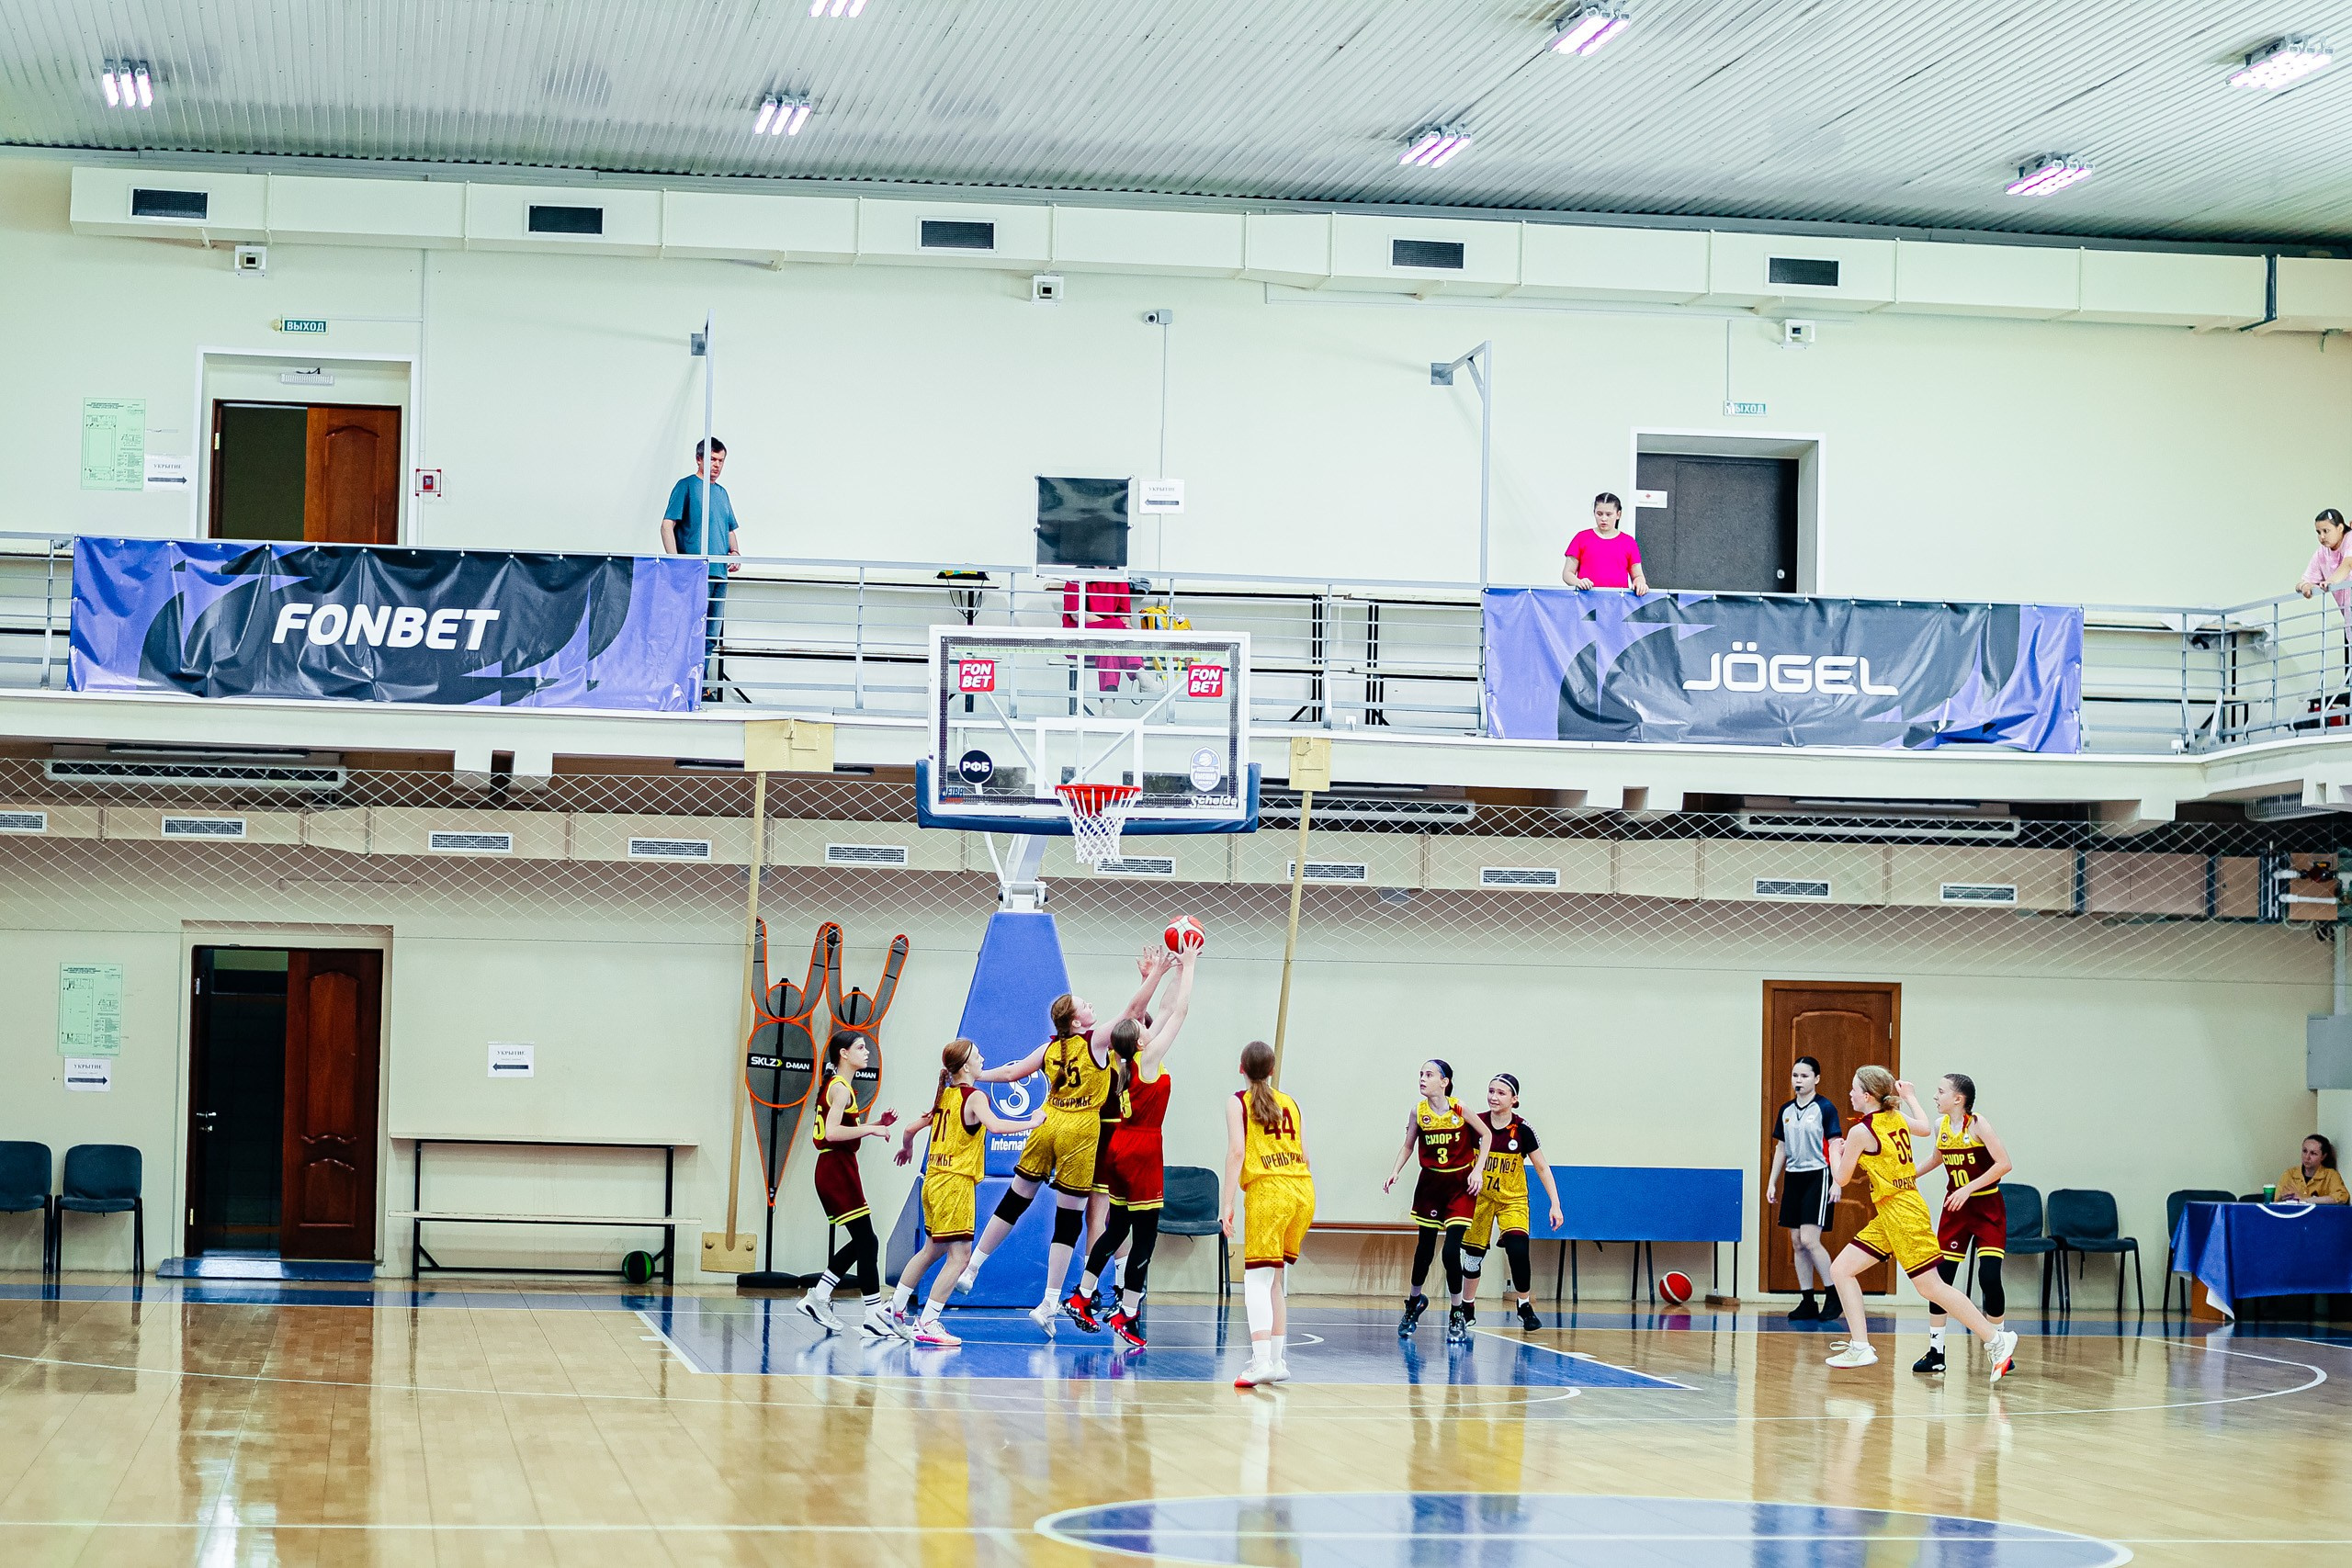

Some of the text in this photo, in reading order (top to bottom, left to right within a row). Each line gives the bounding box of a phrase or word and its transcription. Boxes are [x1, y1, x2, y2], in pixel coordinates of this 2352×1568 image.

[287, 321, 324, 332] ВЫХОД
[272, 603, 501, 651] FONBET
[961, 663, 992, 675] FON
[1190, 669, 1220, 681] FON
[1682, 641, 1899, 696] JÖGEL
[961, 675, 992, 688] BET
[1190, 681, 1220, 694] BET
[962, 761, 989, 773] РФБ
[751, 1056, 809, 1070] SKLZ D-MAN
[855, 1071, 876, 1079] D-MAN
[1264, 1107, 1295, 1141] 44
[1454, 1132, 1462, 1142] 5
[990, 1137, 1027, 1151] Internat
[1887, 1128, 1914, 1165] 59
[1437, 1147, 1449, 1165] 3
[1967, 1153, 1976, 1165] 5
[1487, 1175, 1500, 1192] 74
[1951, 1169, 1970, 1188] 10
